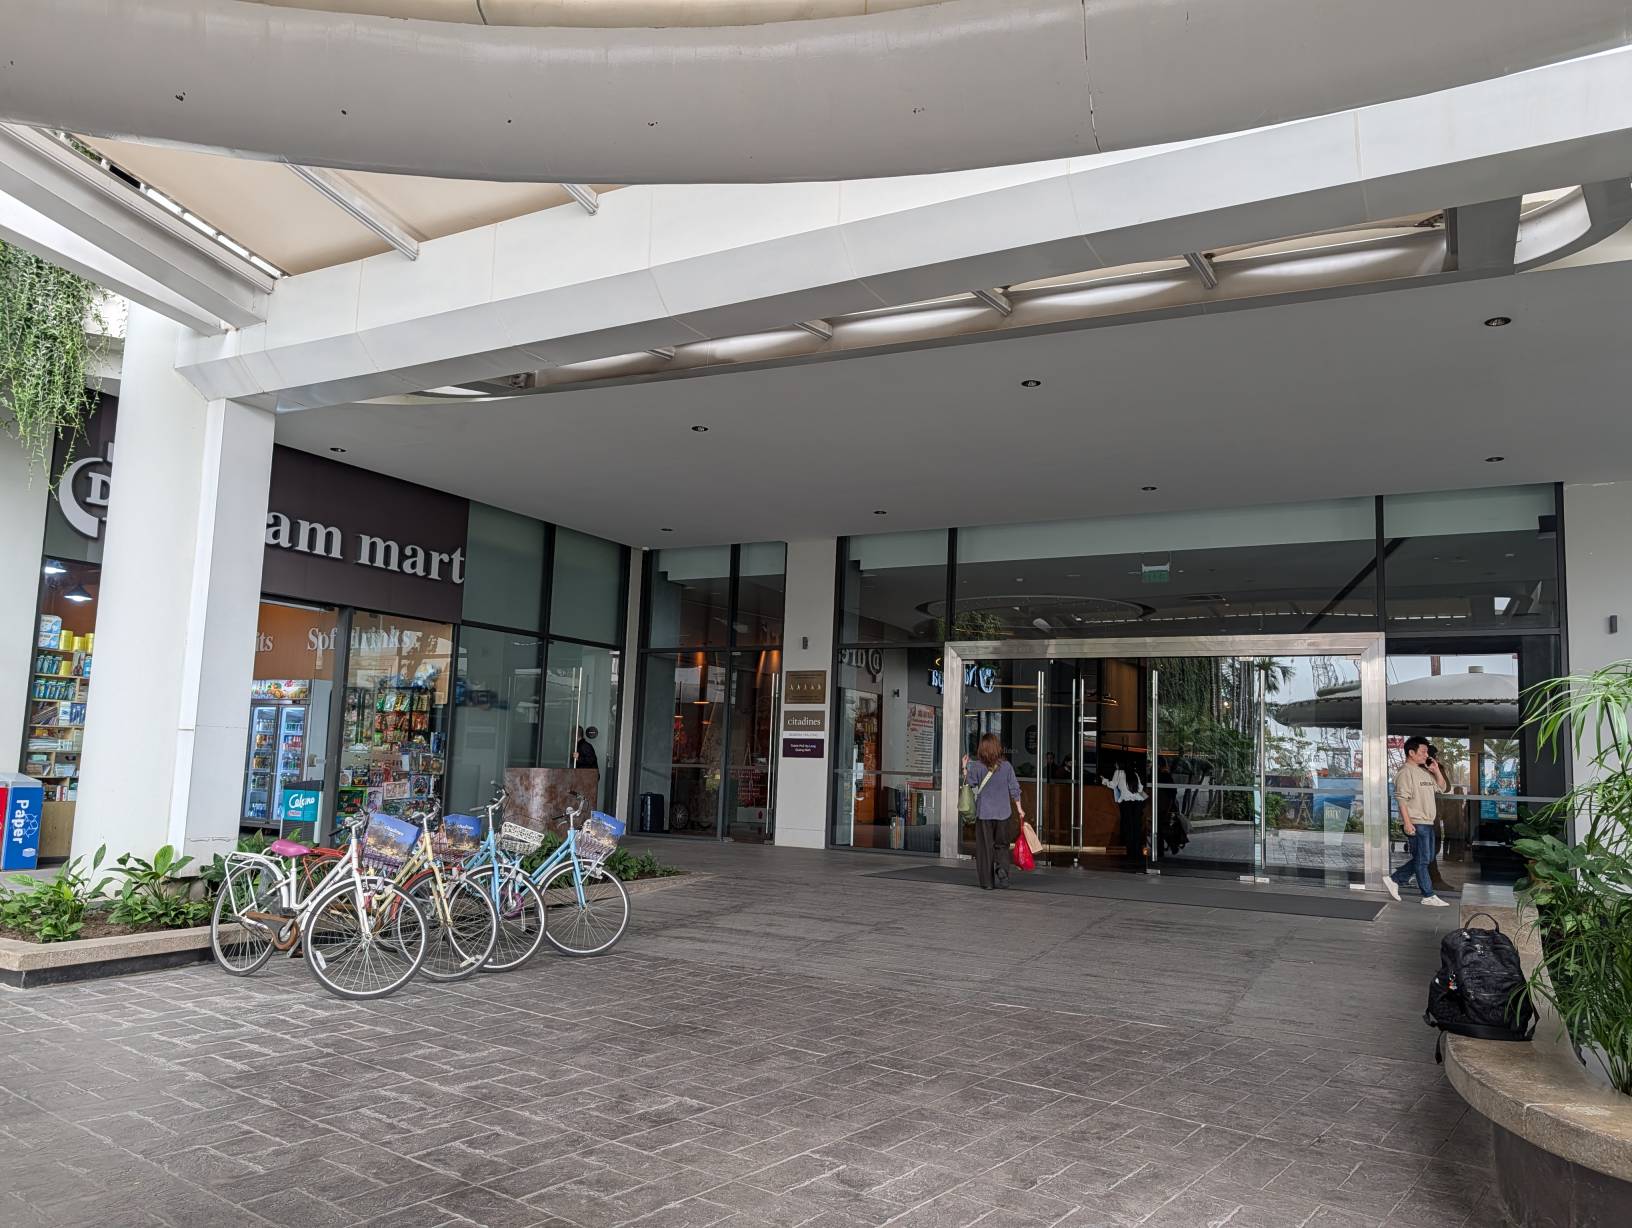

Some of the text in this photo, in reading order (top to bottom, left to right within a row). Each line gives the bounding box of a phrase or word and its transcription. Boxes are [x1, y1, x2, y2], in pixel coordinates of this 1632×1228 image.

[358, 533, 465, 584] mart
[307, 627, 338, 651] Sof
[787, 717, 821, 726] citadines
[11, 799, 30, 844] Paper
